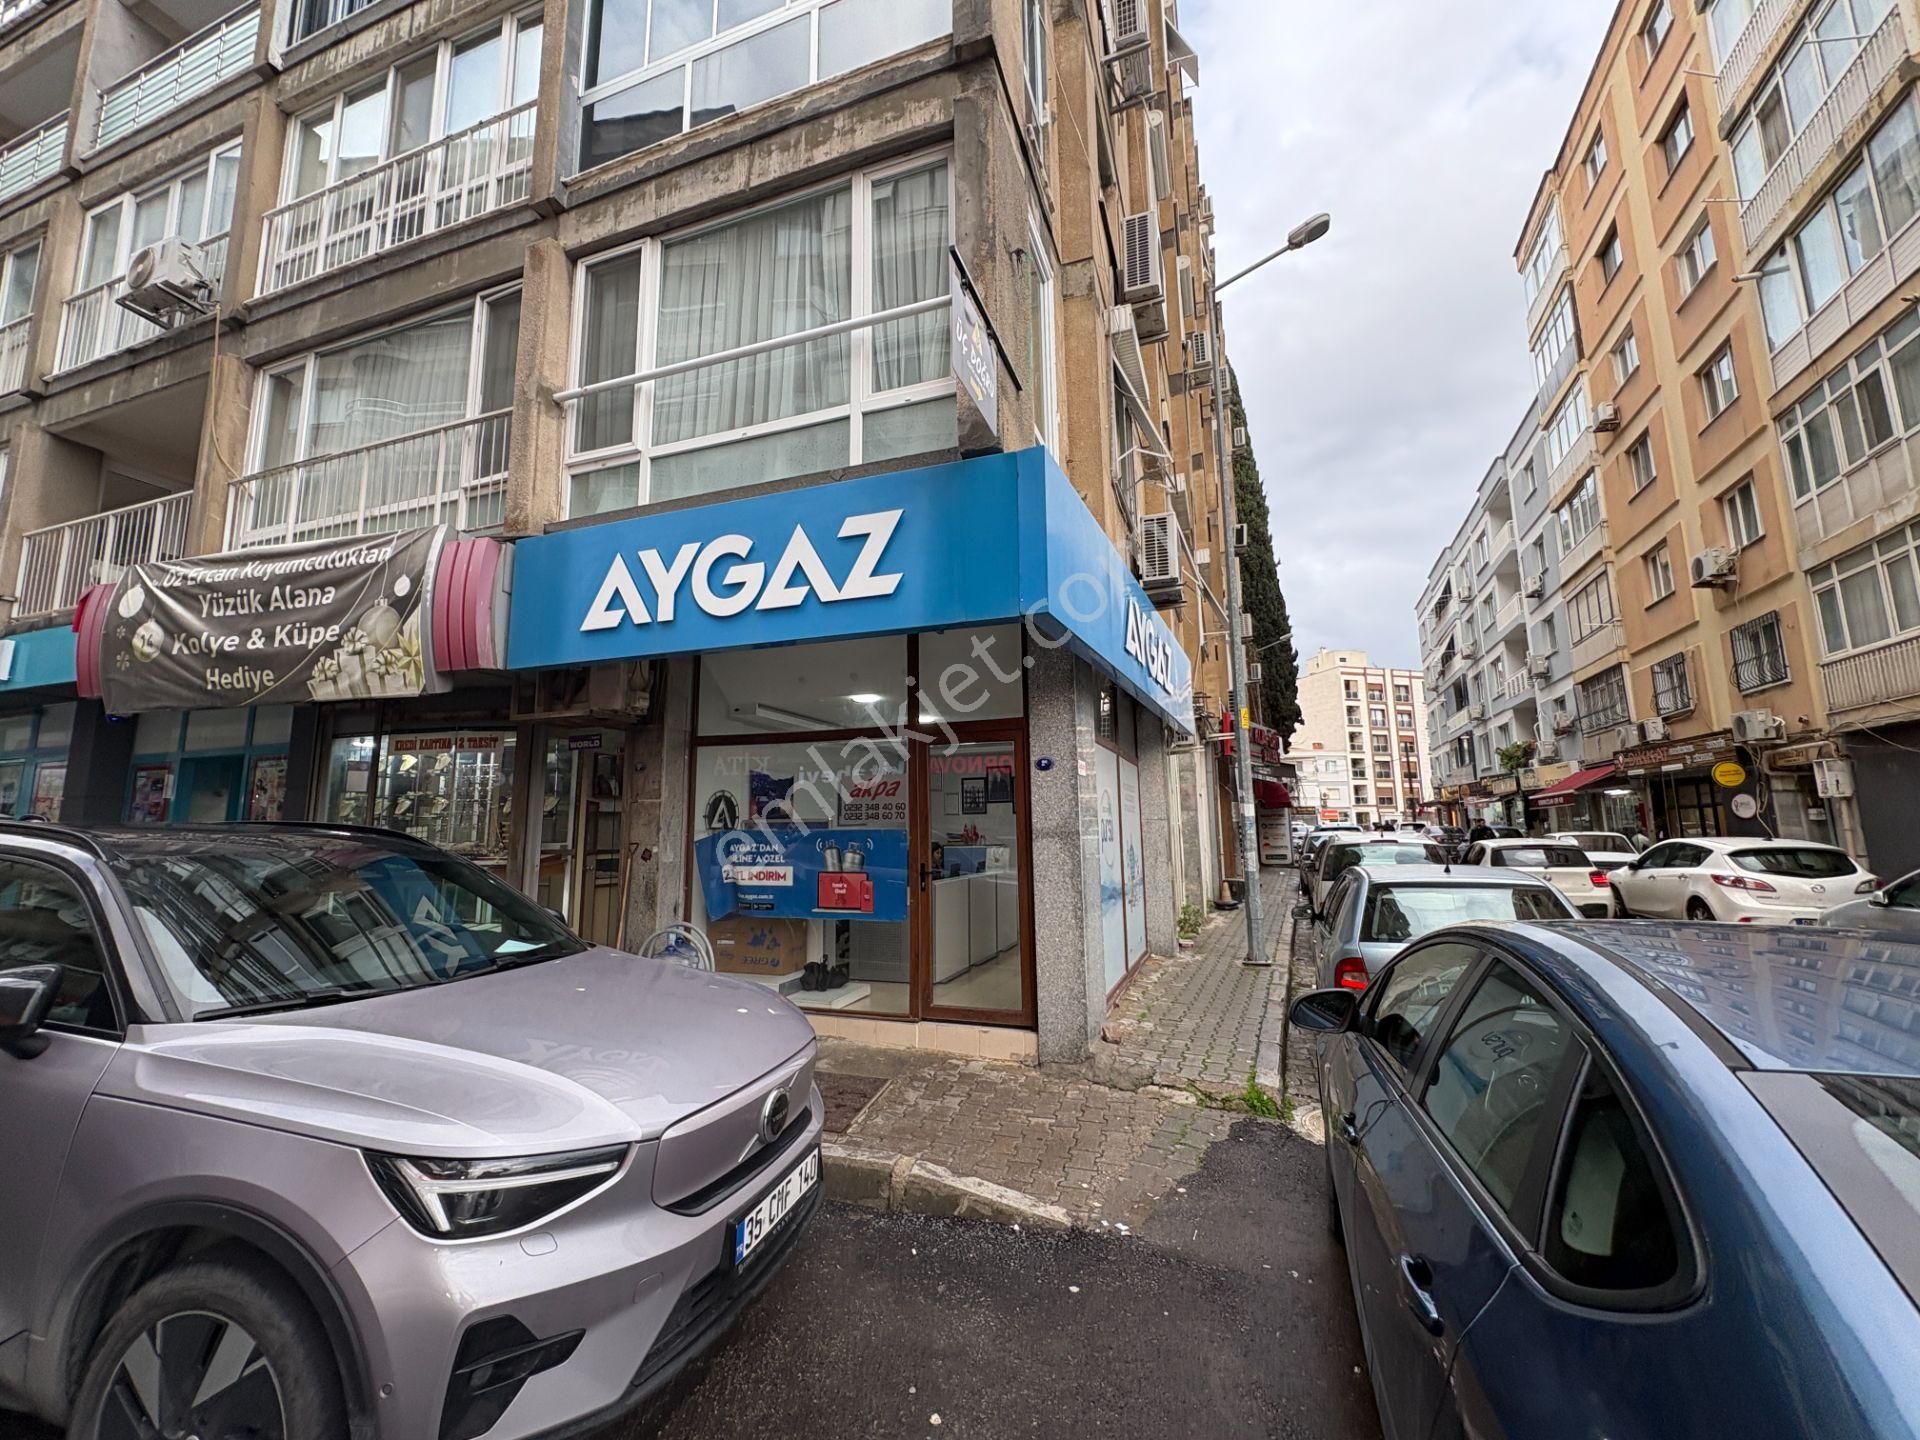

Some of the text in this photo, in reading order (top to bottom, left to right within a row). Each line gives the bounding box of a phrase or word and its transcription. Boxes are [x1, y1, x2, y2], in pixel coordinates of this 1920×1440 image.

[187, 570, 241, 587] Ercan
[579, 508, 905, 633] AYGAZ
[198, 585, 336, 619] Yüzük Alana
[171, 623, 341, 657] Kolye & Küpe
[1125, 595, 1174, 696] AYGAZ
[206, 665, 275, 691] Hediye
[569, 739, 601, 749] WORLD
[745, 1207, 763, 1250] 35
[768, 1177, 792, 1225] CMF
[798, 1154, 817, 1192] 140
